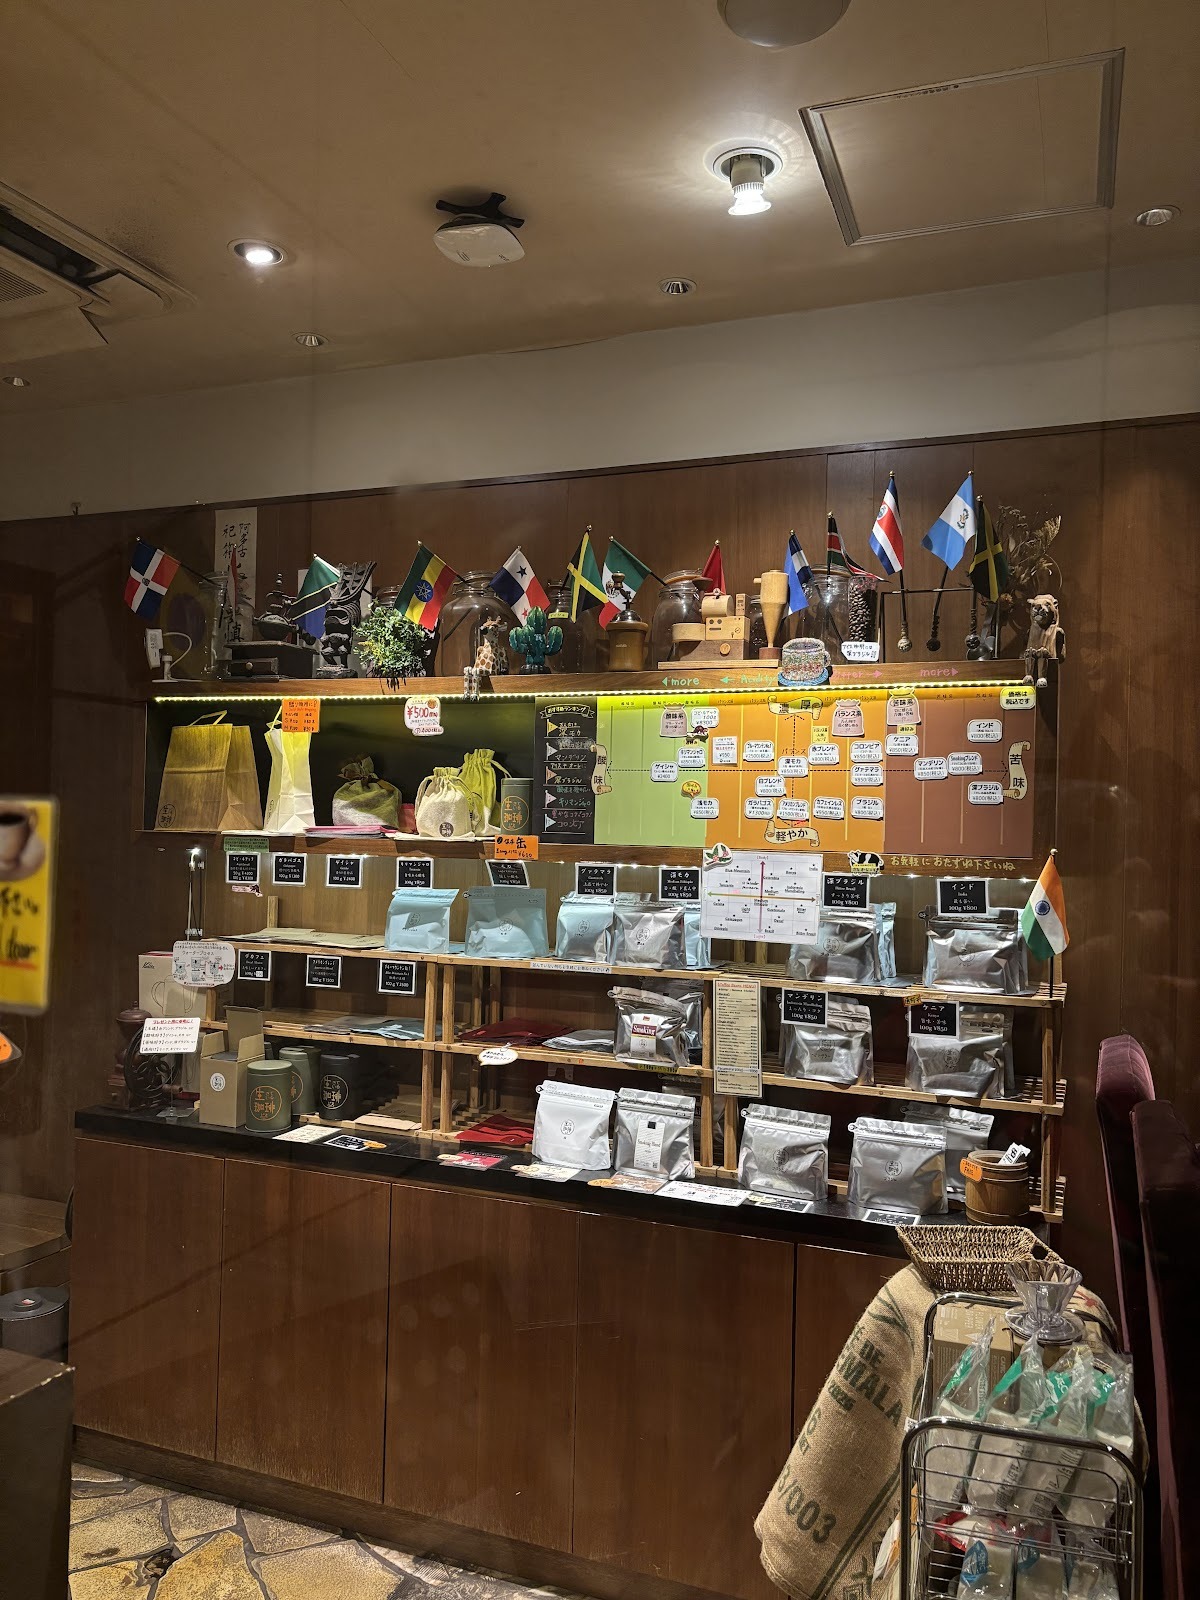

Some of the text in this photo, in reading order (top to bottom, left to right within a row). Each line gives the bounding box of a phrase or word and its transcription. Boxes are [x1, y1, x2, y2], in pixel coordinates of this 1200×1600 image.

[1009, 753, 1026, 789] 苦味
[775, 829, 809, 843] 軽やか
[787, 993, 823, 1002] マンデリン
[922, 1004, 945, 1012] ケニア
[633, 1024, 656, 1036] Smoking
[859, 1339, 886, 1369] DE
